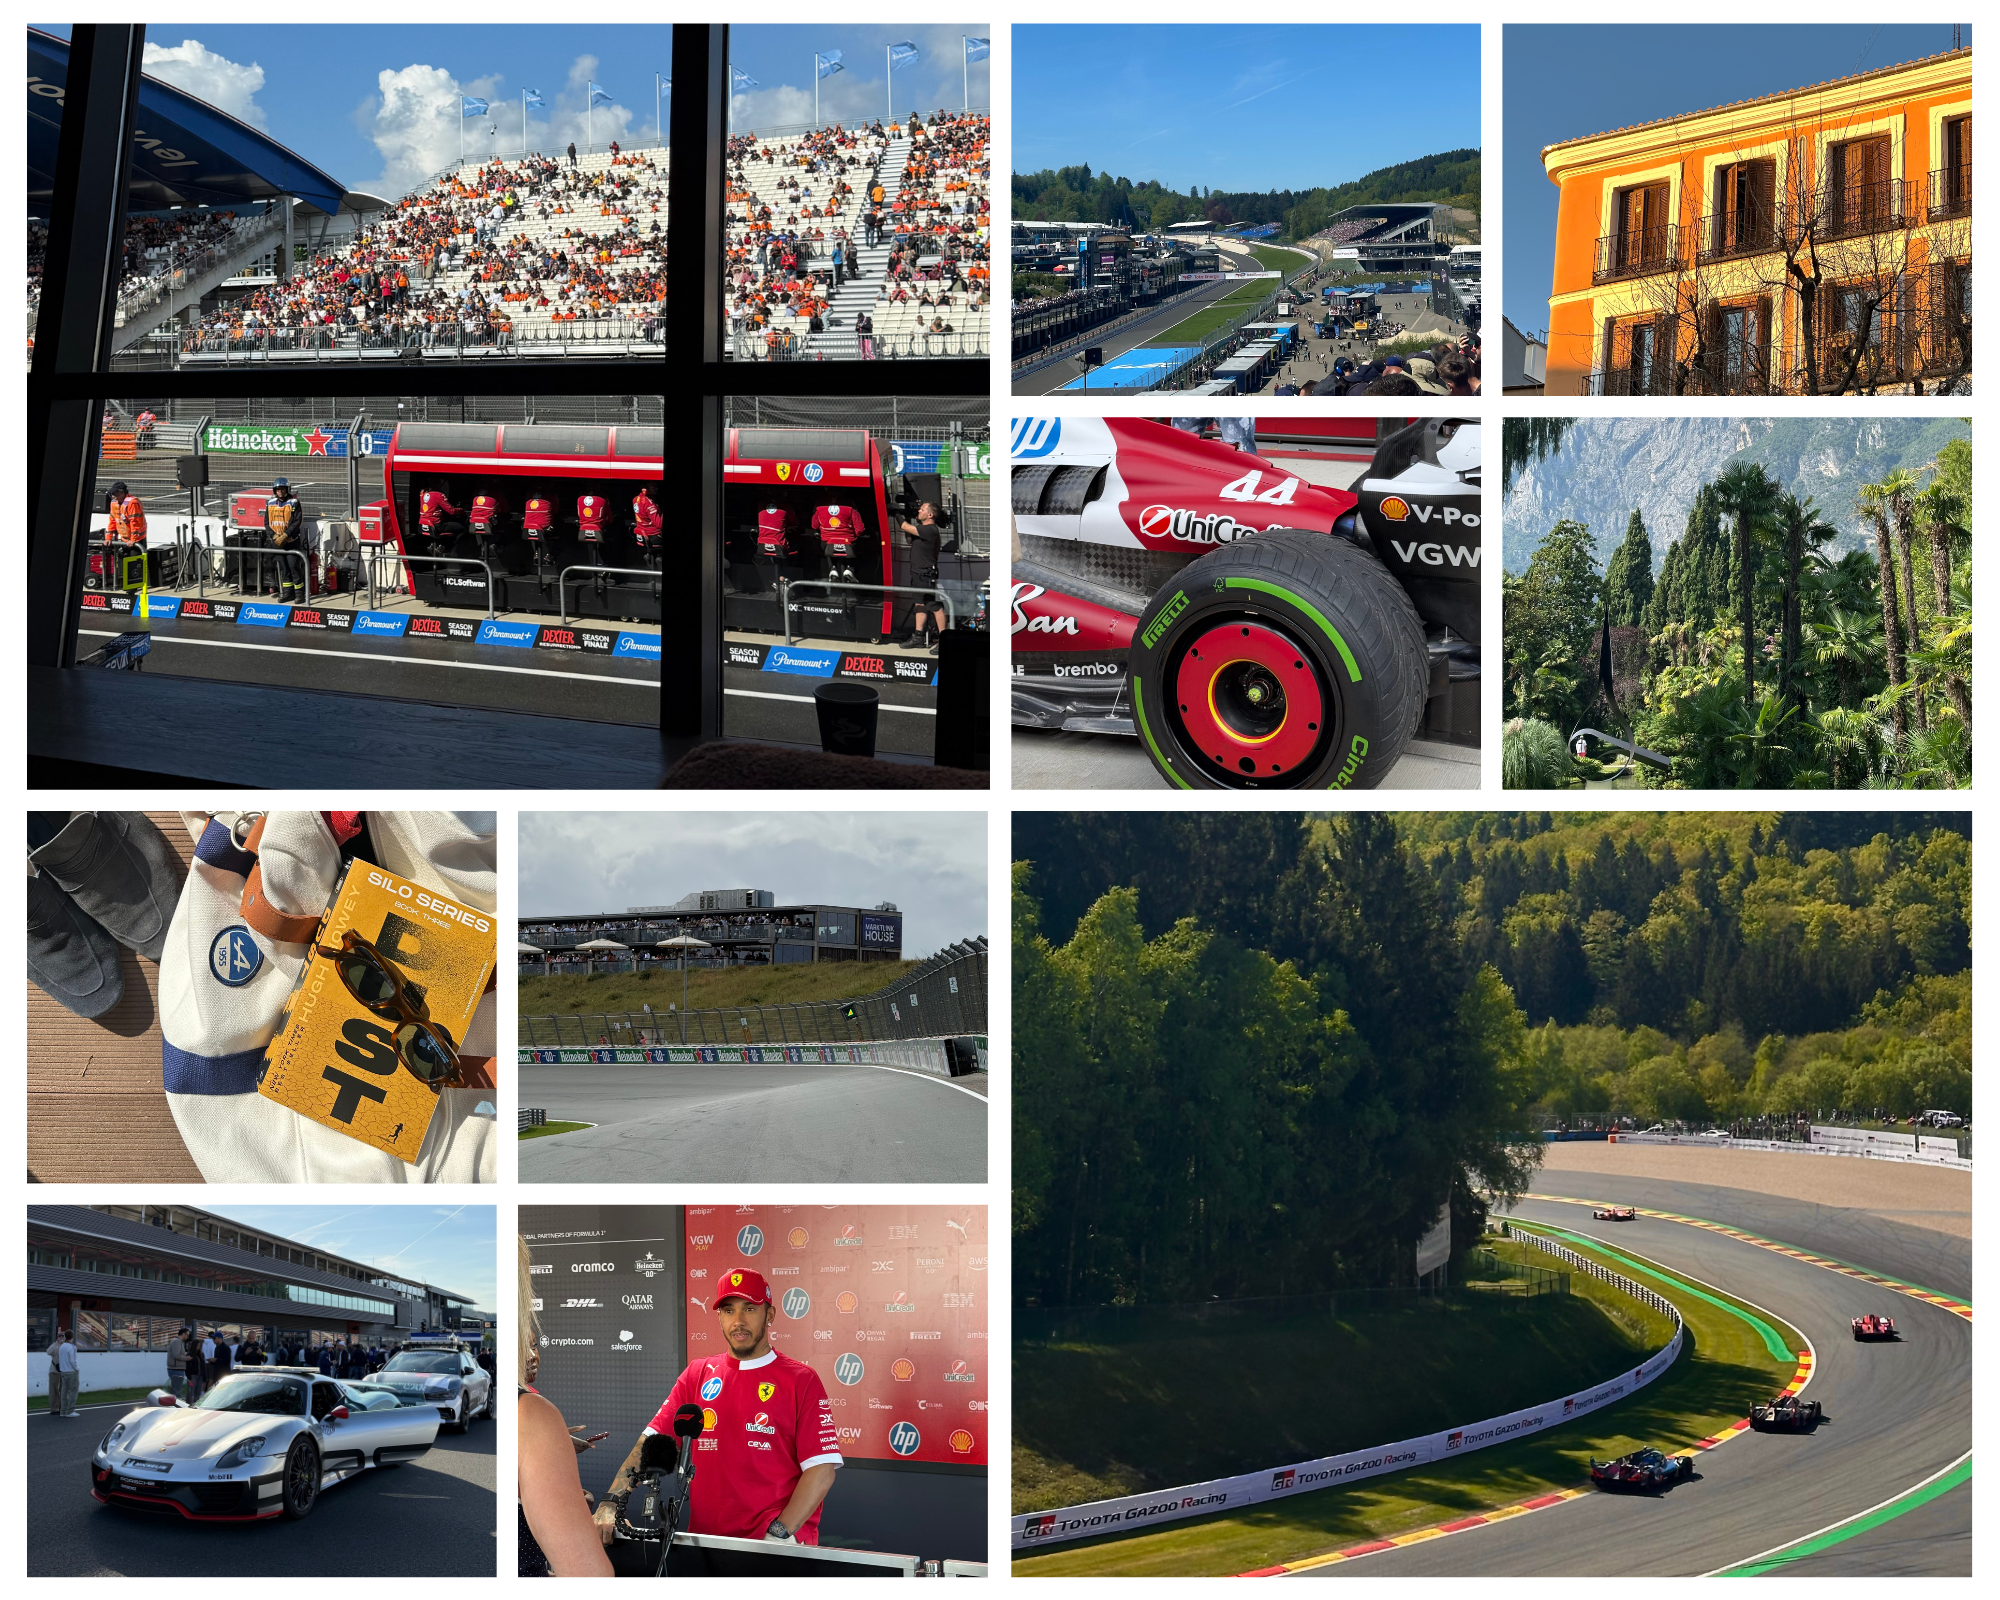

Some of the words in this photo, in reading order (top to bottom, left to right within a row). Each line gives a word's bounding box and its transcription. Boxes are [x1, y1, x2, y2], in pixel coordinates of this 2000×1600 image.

[207, 428, 298, 452] Heineken
[804, 463, 822, 482] hp
[1218, 469, 1300, 506] 44
[1410, 503, 1481, 527] V-Po
[82, 594, 106, 607] DEXTER
[110, 597, 131, 605] SEASON
[183, 600, 209, 614] DEXTER
[214, 604, 236, 612] SEASON
[215, 610, 235, 618] FINALE
[803, 605, 843, 614] TECHNOLOGY
[293, 609, 321, 623] DEXTER
[326, 613, 350, 621] SEASON
[358, 615, 402, 630] Paramount+
[1141, 589, 1190, 650] PIRELLI
[328, 619, 349, 627] FINALE
[412, 617, 441, 633] DEXTER
[448, 622, 473, 631] SEASON
[449, 629, 472, 637] FINALE
[483, 625, 532, 640] Paramount+
[543, 628, 575, 644] DEXTER
[582, 633, 609, 642] SEASON
[583, 641, 609, 649] FINALE
[729, 647, 760, 657] SEASON
[731, 655, 759, 664] FINALE
[772, 651, 831, 669] Paramount+
[845, 655, 885, 673] DEXTER
[894, 661, 928, 671] SEASON
[841, 670, 893, 679] RESURRECTION
[896, 668, 927, 678] FINALE
[1053, 661, 1118, 677] brembo
[367, 871, 413, 899] SILO
[415, 892, 491, 933] SERIES
[394, 900, 420, 916] BOOK
[422, 912, 452, 930] THREE
[865, 930, 895, 943] HOUSE
[218, 945, 227, 967] 1955
[298, 964, 330, 1023] HUGH
[278, 1050, 290, 1069] YORK
[287, 1024, 300, 1046] TIMES
[559, 1050, 589, 1063] Heineken
[615, 1050, 644, 1063] Heineken
[667, 1050, 696, 1063] Heineken
[689, 1208, 712, 1216] ambipar
[888, 1224, 919, 1240] IBM
[690, 1235, 714, 1245] VGW
[740, 1225, 760, 1256] hp
[834, 1237, 863, 1246] UniCredit
[571, 1262, 615, 1273] aramco
[916, 1258, 944, 1266] PERONI
[771, 1266, 800, 1276] PIRELLI
[820, 1265, 847, 1274] ambipar
[565, 1298, 598, 1308] DHL
[621, 1294, 653, 1306] QATAR
[785, 1288, 806, 1319] hp
[942, 1292, 975, 1308] IBM
[885, 1303, 915, 1312] UniCredit
[690, 1332, 708, 1341] ZCG
[909, 1331, 942, 1340] PIRELLI
[550, 1338, 594, 1347] crypto.com
[611, 1342, 642, 1352] salesforce
[838, 1353, 861, 1386] hp
[943, 1372, 975, 1382] UniCredit
[703, 1378, 721, 1400] hp
[746, 1422, 775, 1434] UniCredit
[1446, 1438, 1462, 1450] GR
[1463, 1430, 1494, 1445] TOYOTA
[1495, 1423, 1521, 1436] GAZOO
[1521, 1416, 1544, 1429] Racing
[698, 1438, 718, 1451] IBM
[892, 1422, 917, 1455] hp
[208, 1473, 226, 1481] Mobil
[1272, 1477, 1294, 1491] GR
[1298, 1468, 1342, 1484] TOYOTA
[1345, 1459, 1382, 1475] GAZOO
[1384, 1451, 1417, 1465] Racing
[120, 1476, 156, 1486] PORSCHE
[1023, 1523, 1055, 1538] GR
[1059, 1512, 1121, 1532] TOYOTA
[1125, 1501, 1178, 1520] GAZOO
[1180, 1493, 1228, 1509] Racing
